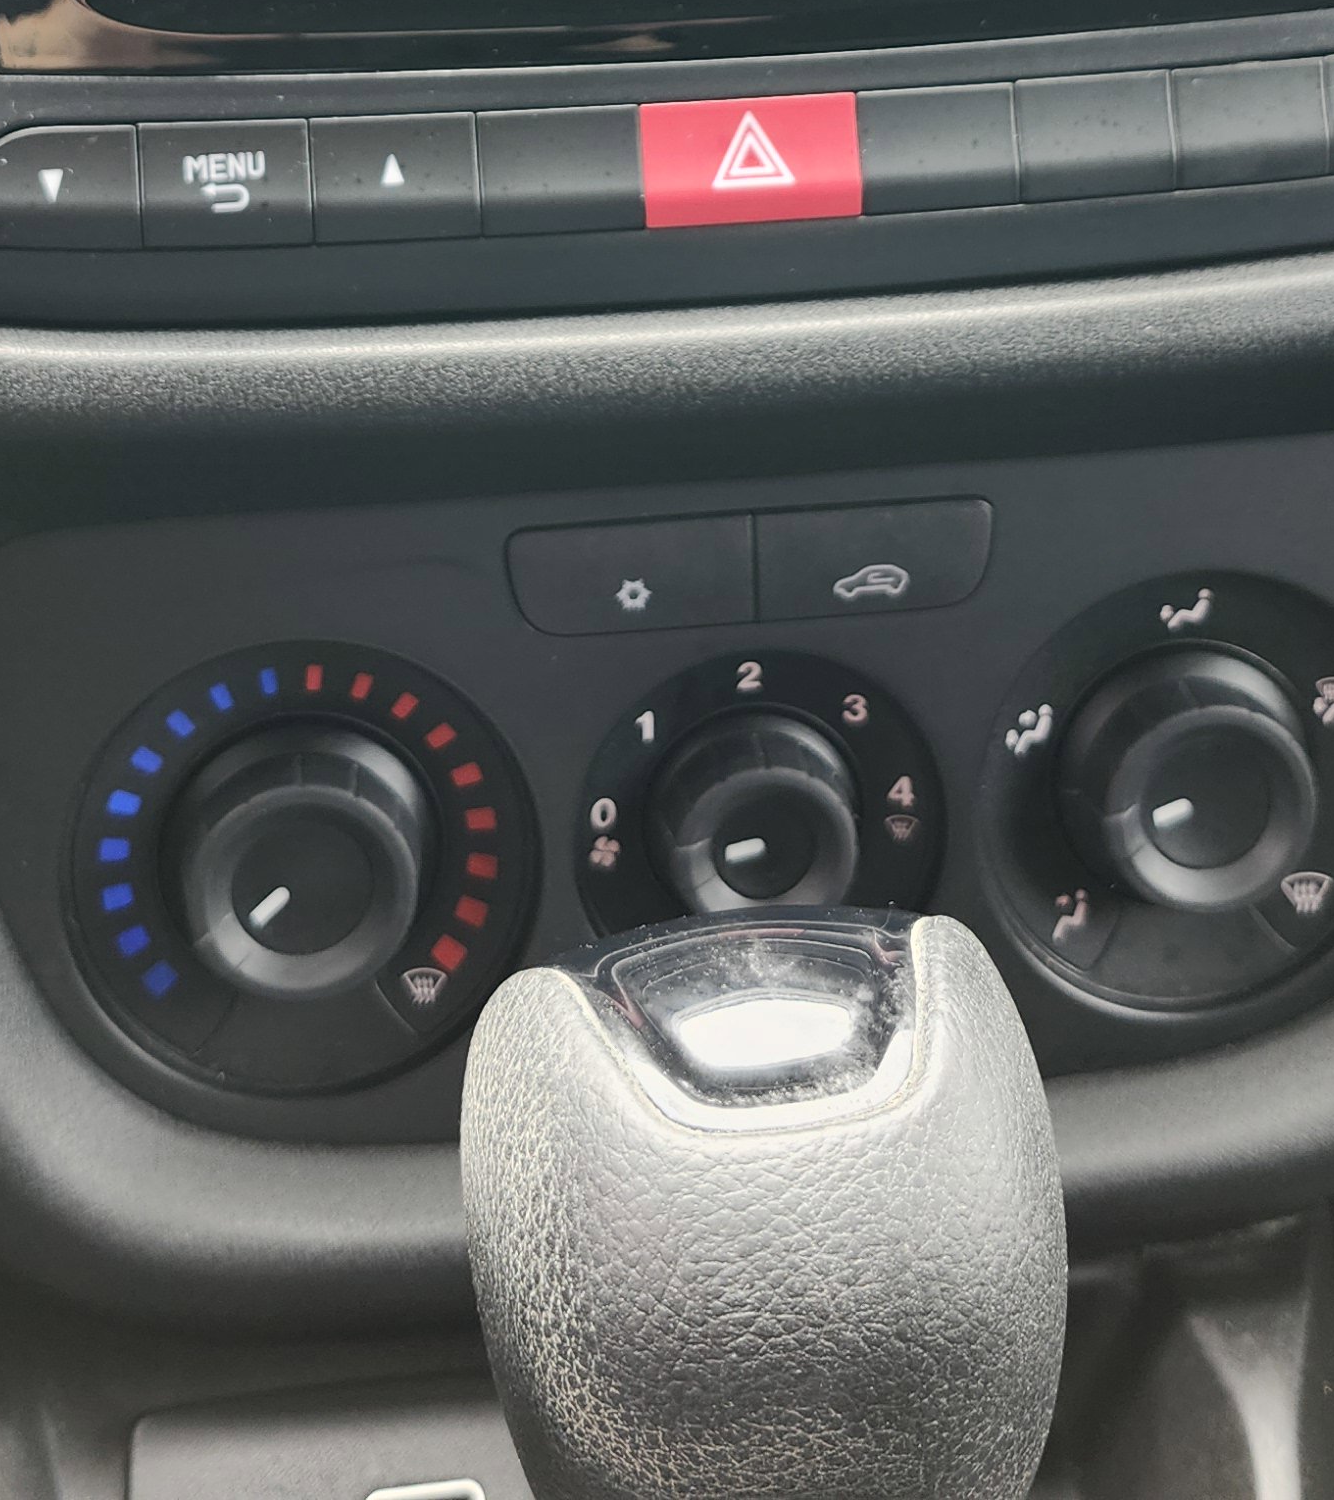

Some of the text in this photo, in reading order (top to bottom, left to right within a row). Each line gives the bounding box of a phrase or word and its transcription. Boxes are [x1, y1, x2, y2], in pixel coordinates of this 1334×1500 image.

[182, 150, 266, 184] MENU
[736, 660, 764, 691] 2
[841, 693, 868, 724] 3
[634, 710, 655, 742] 1
[887, 774, 916, 806] 4
[589, 796, 617, 829] 0
